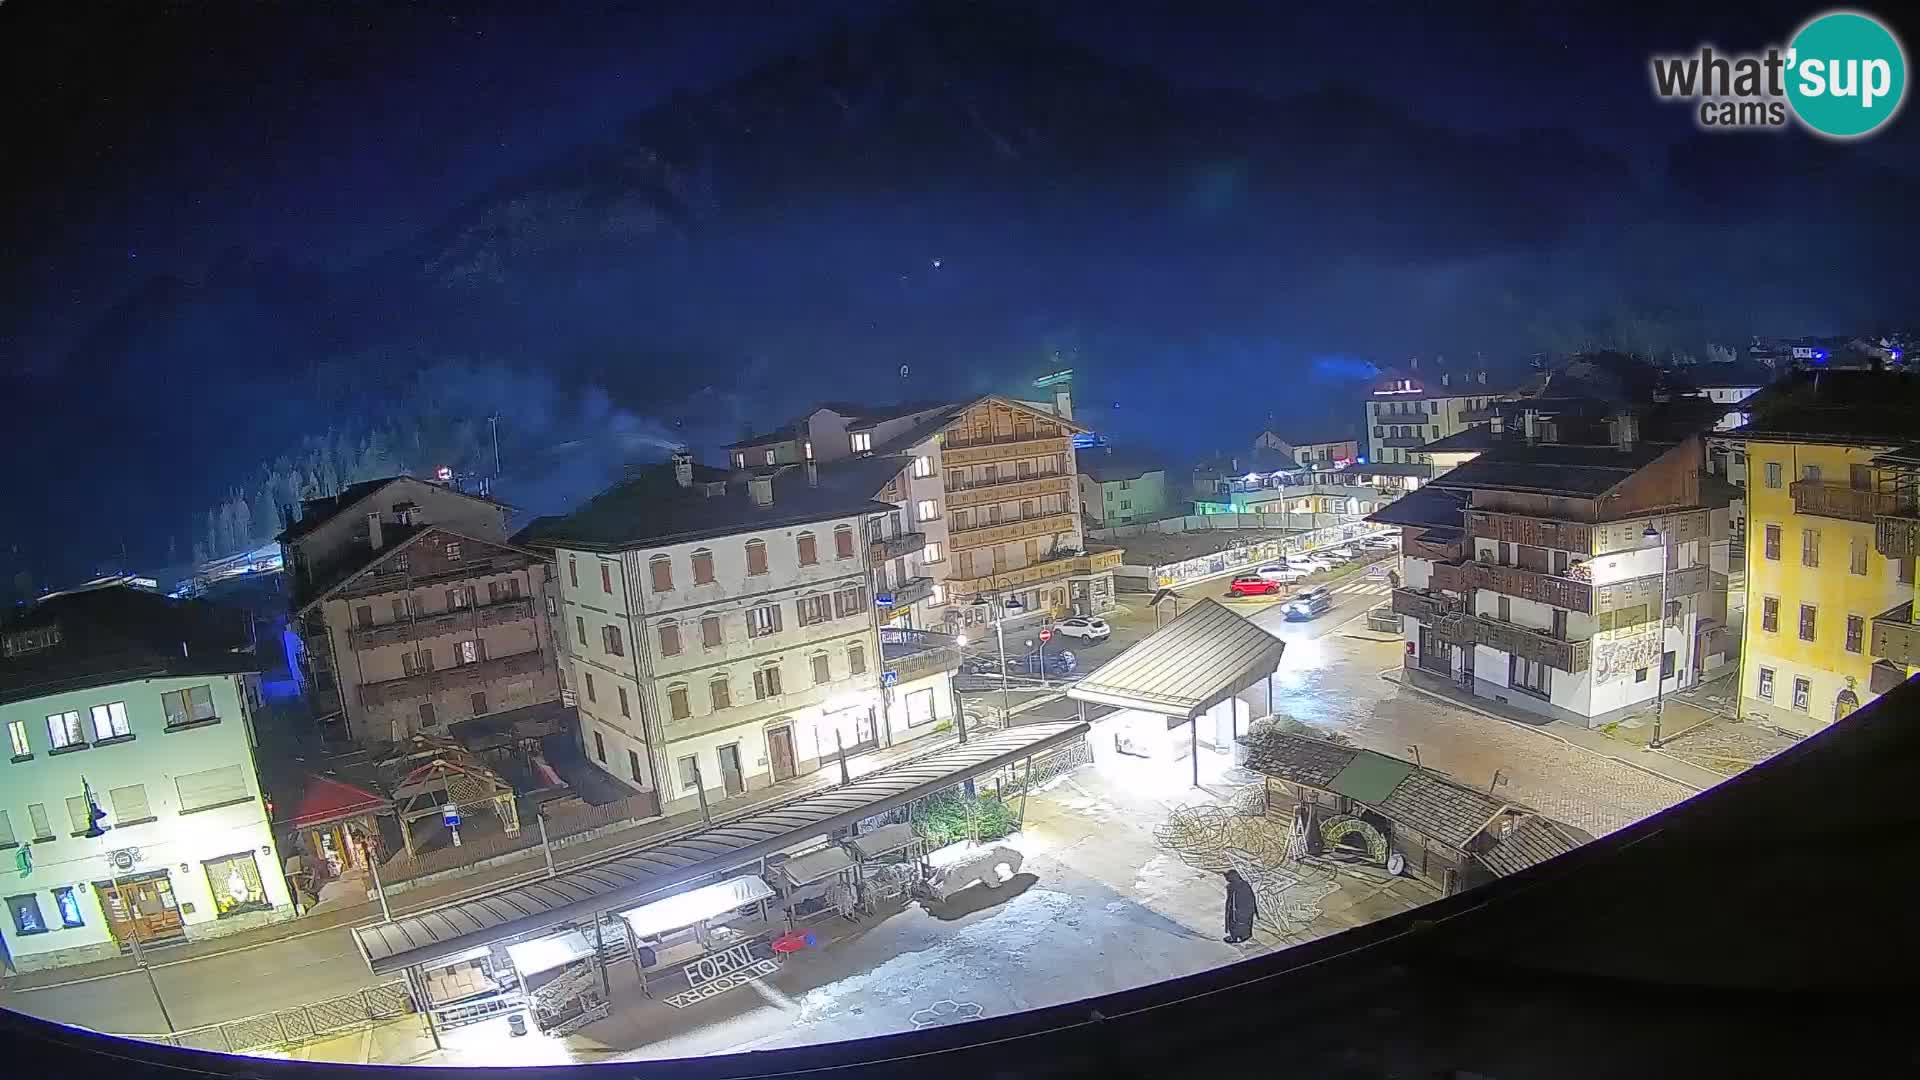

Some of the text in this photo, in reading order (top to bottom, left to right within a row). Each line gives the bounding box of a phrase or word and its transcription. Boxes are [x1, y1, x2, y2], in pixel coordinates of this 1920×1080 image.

[663, 959, 780, 1008] DI SOPRA
[683, 939, 763, 988] FORNI
